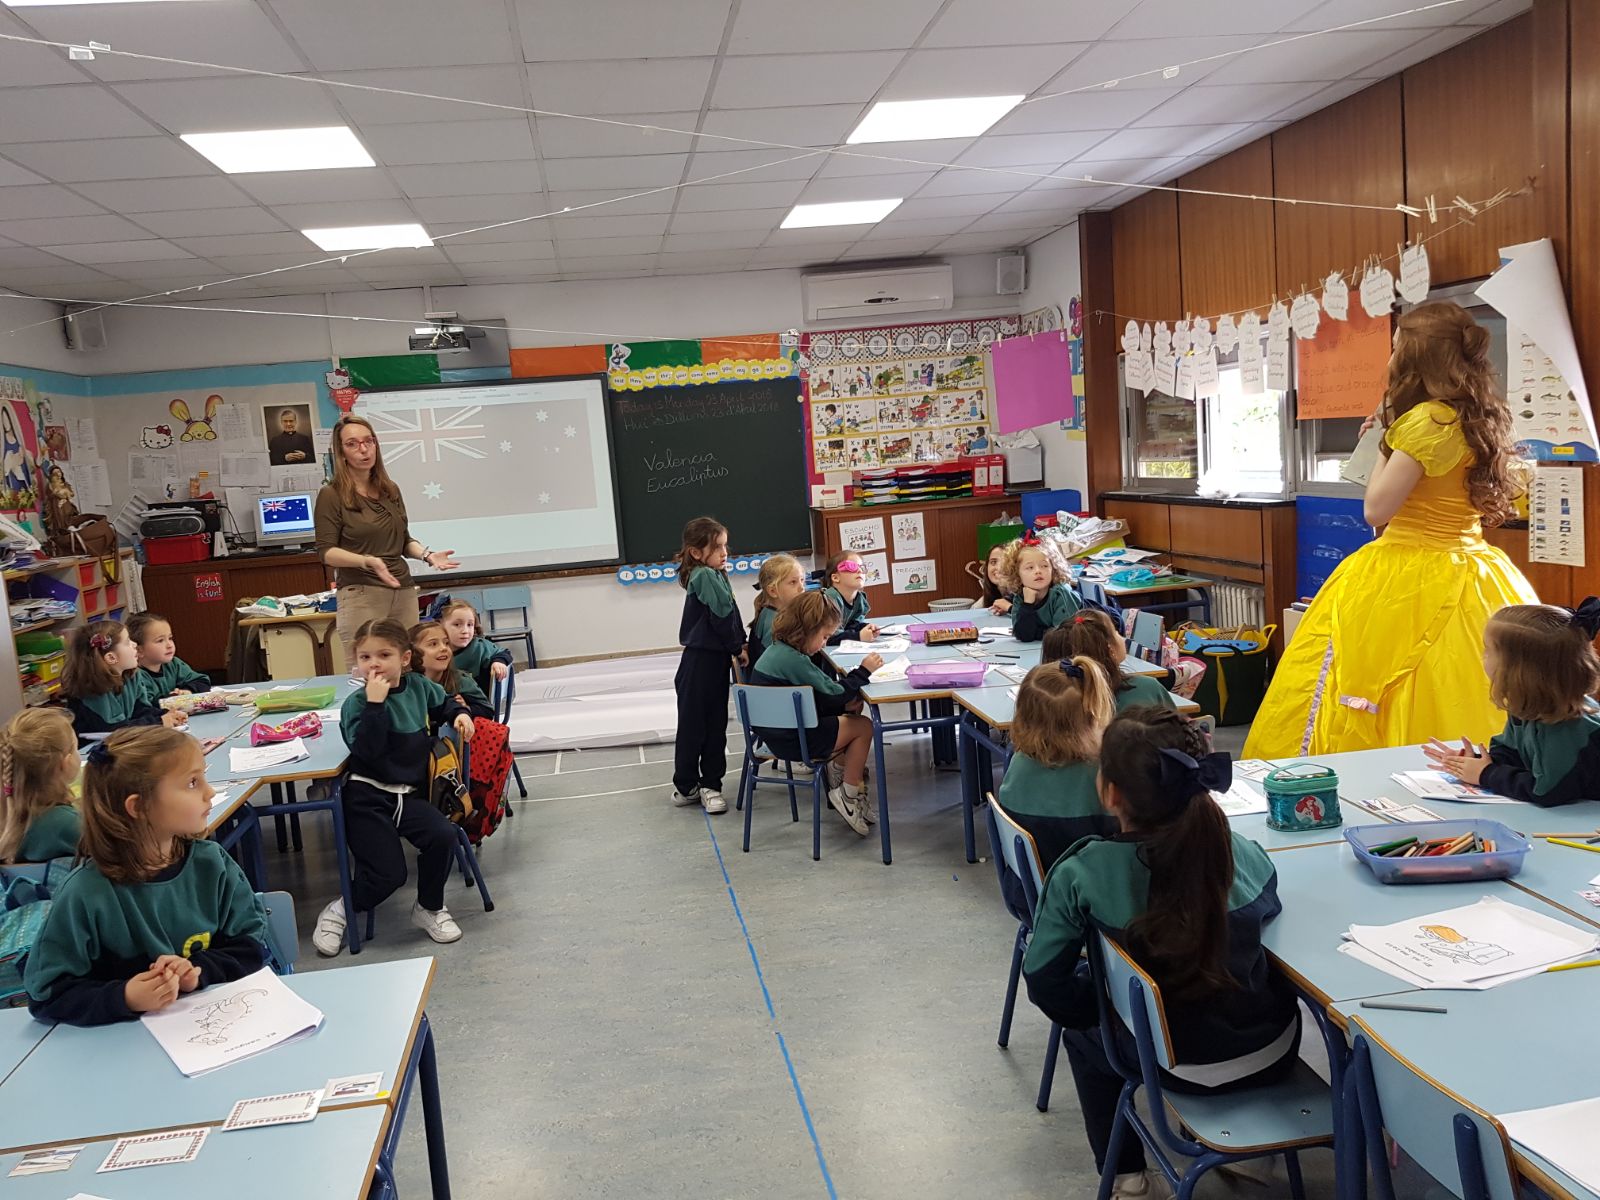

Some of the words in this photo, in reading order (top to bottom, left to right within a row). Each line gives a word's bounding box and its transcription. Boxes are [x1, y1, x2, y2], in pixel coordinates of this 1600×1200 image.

[644, 448, 719, 472] Valencia
[647, 465, 730, 493] Eucaliptus
[844, 525, 880, 535] ESCUCHO
[895, 565, 933, 574] PREGUNTO
[195, 576, 221, 589] English
[204, 587, 222, 598] fun!
